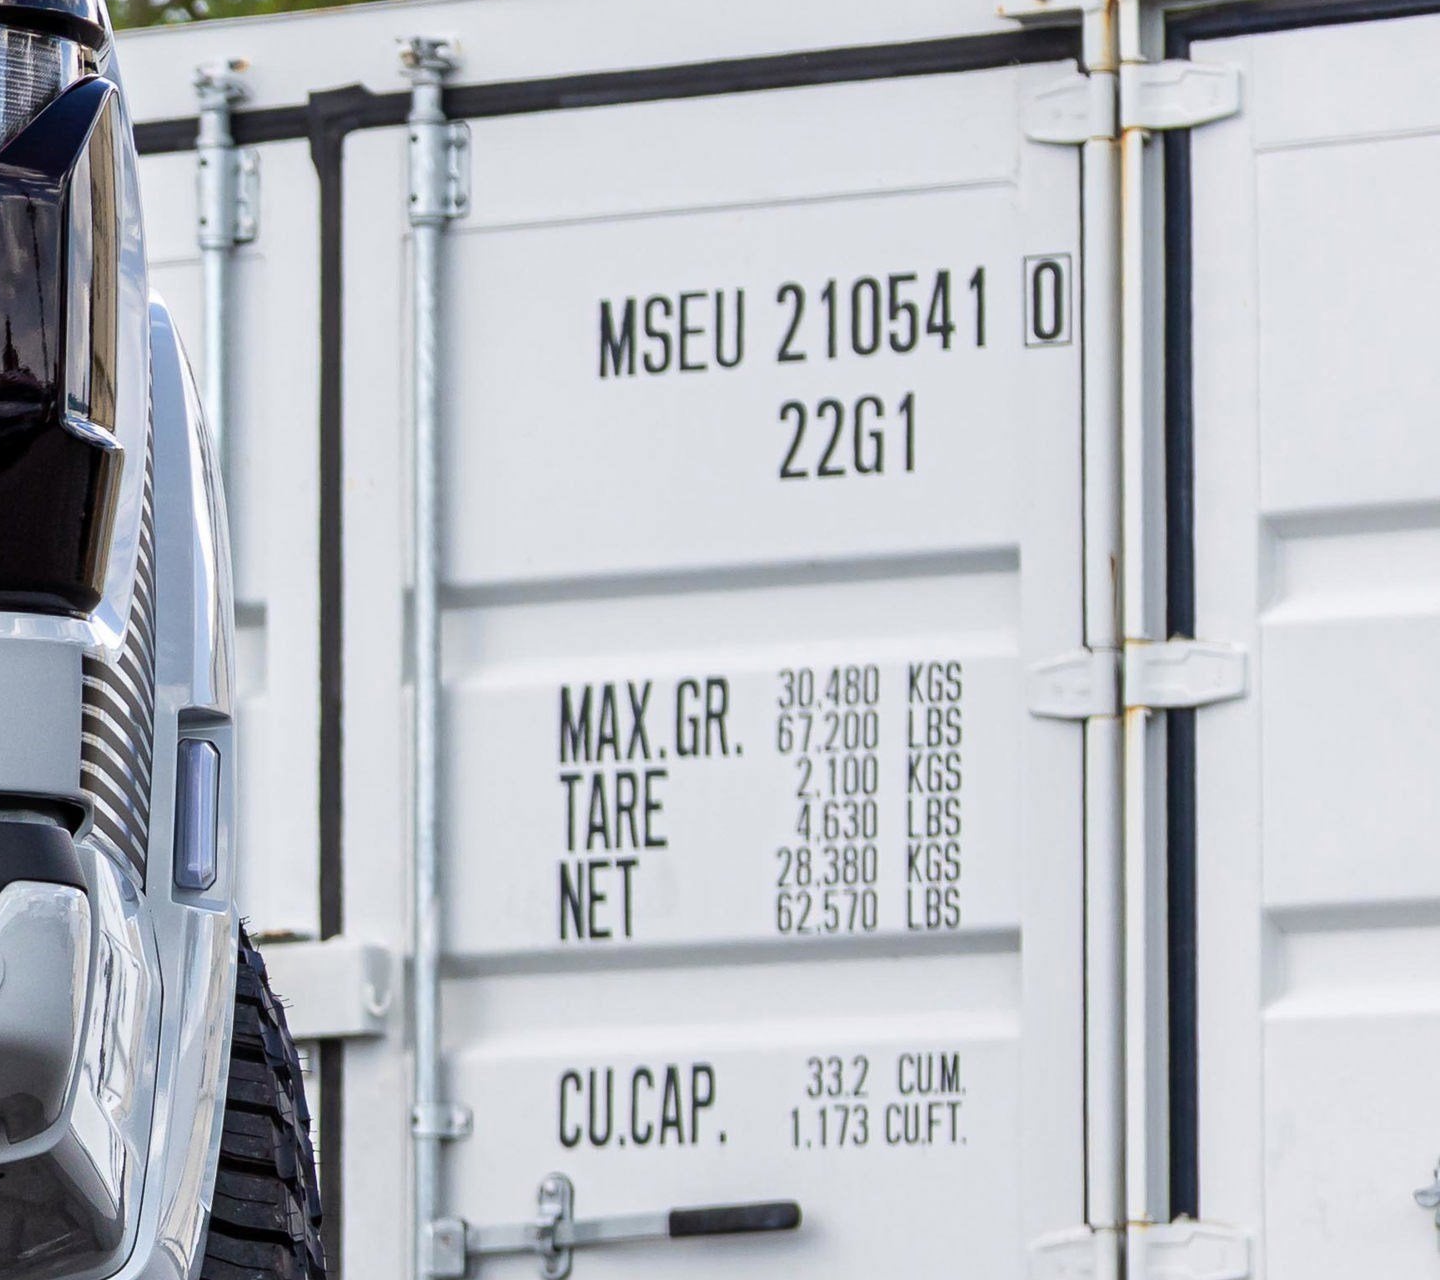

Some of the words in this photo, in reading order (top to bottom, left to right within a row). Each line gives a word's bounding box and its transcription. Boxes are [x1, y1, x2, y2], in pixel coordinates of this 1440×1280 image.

[598, 287, 746, 380] MSEU
[774, 264, 987, 364] 210541
[778, 390, 916, 481] 22G1
[908, 660, 962, 704] KGS
[559, 677, 743, 764] MAX.GR.
[908, 706, 962, 749] LBS
[908, 751, 961, 794] KGS
[559, 768, 669, 852] TARE
[907, 796, 961, 839] LBS
[907, 840, 961, 883] KGS
[559, 858, 639, 941] NET
[907, 885, 961, 930] LBS
[807, 1055, 870, 1097] 33.2
[558, 1062, 727, 1150] CU.CAP.
